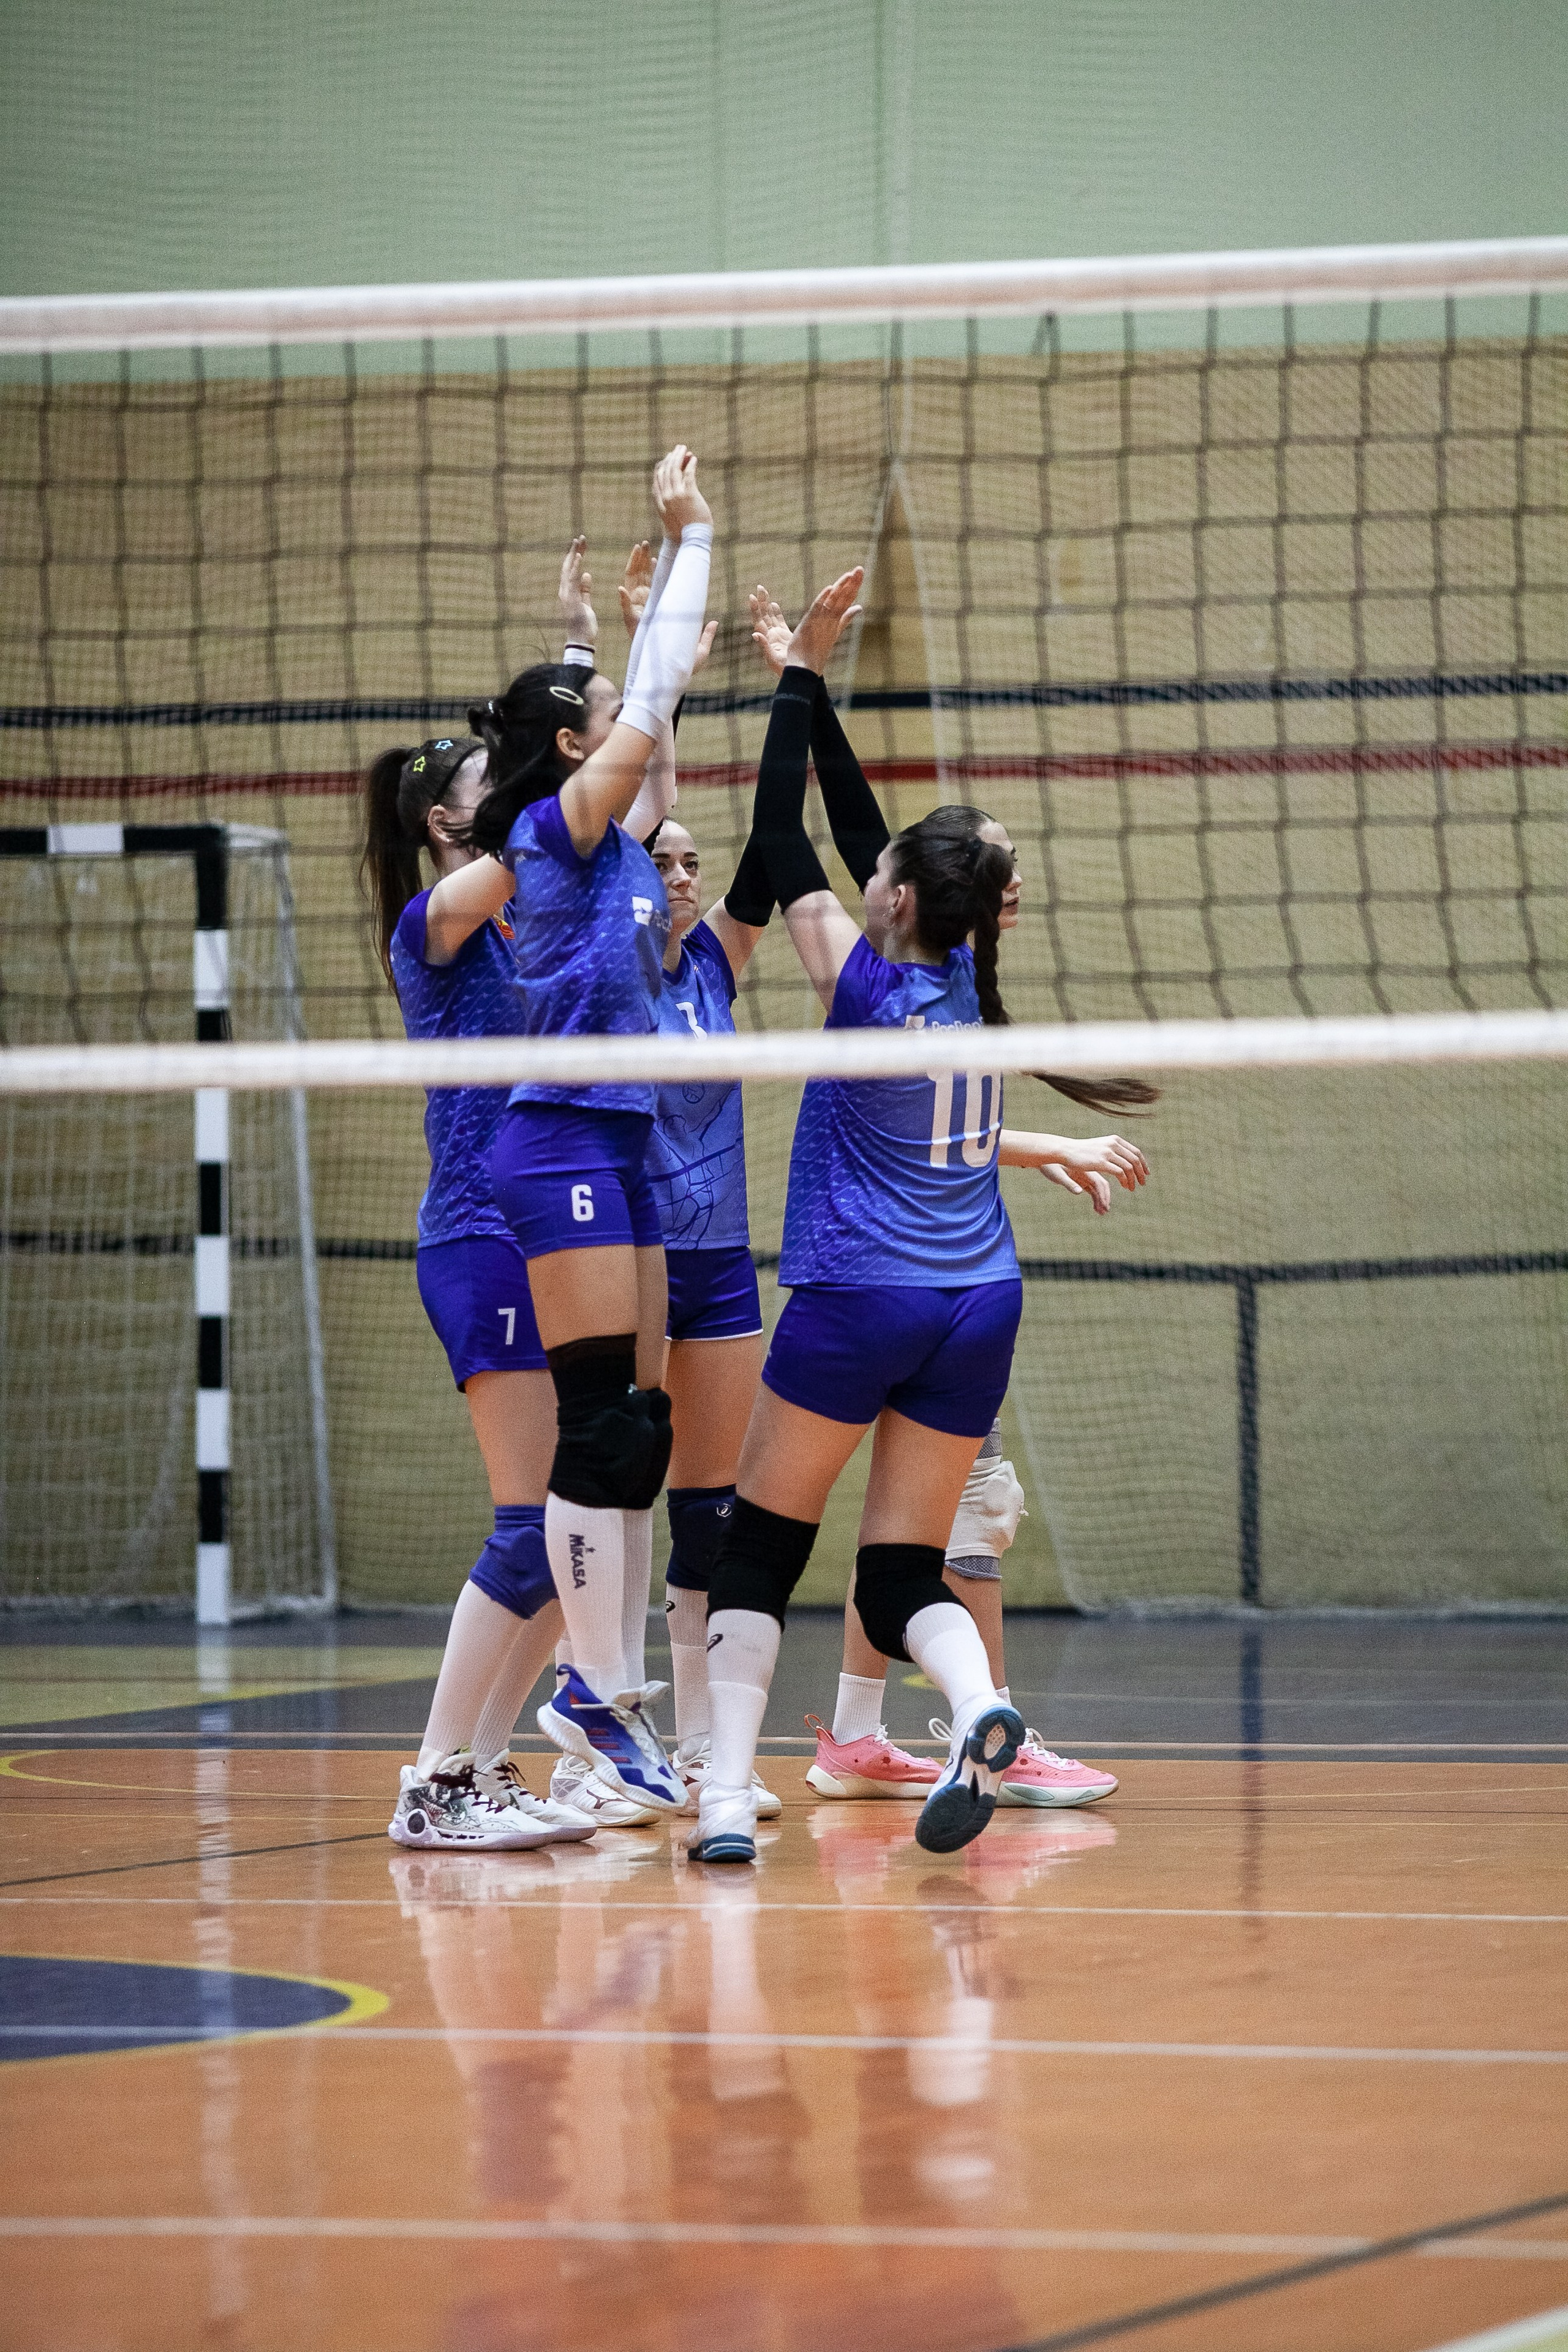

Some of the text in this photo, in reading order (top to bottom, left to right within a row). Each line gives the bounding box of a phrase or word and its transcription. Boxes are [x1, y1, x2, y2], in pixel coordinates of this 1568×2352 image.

[925, 1067, 1001, 1169] 10
[571, 1184, 594, 1221] 6
[497, 1307, 516, 1345] 7
[568, 1534, 587, 1590] MIKASA
